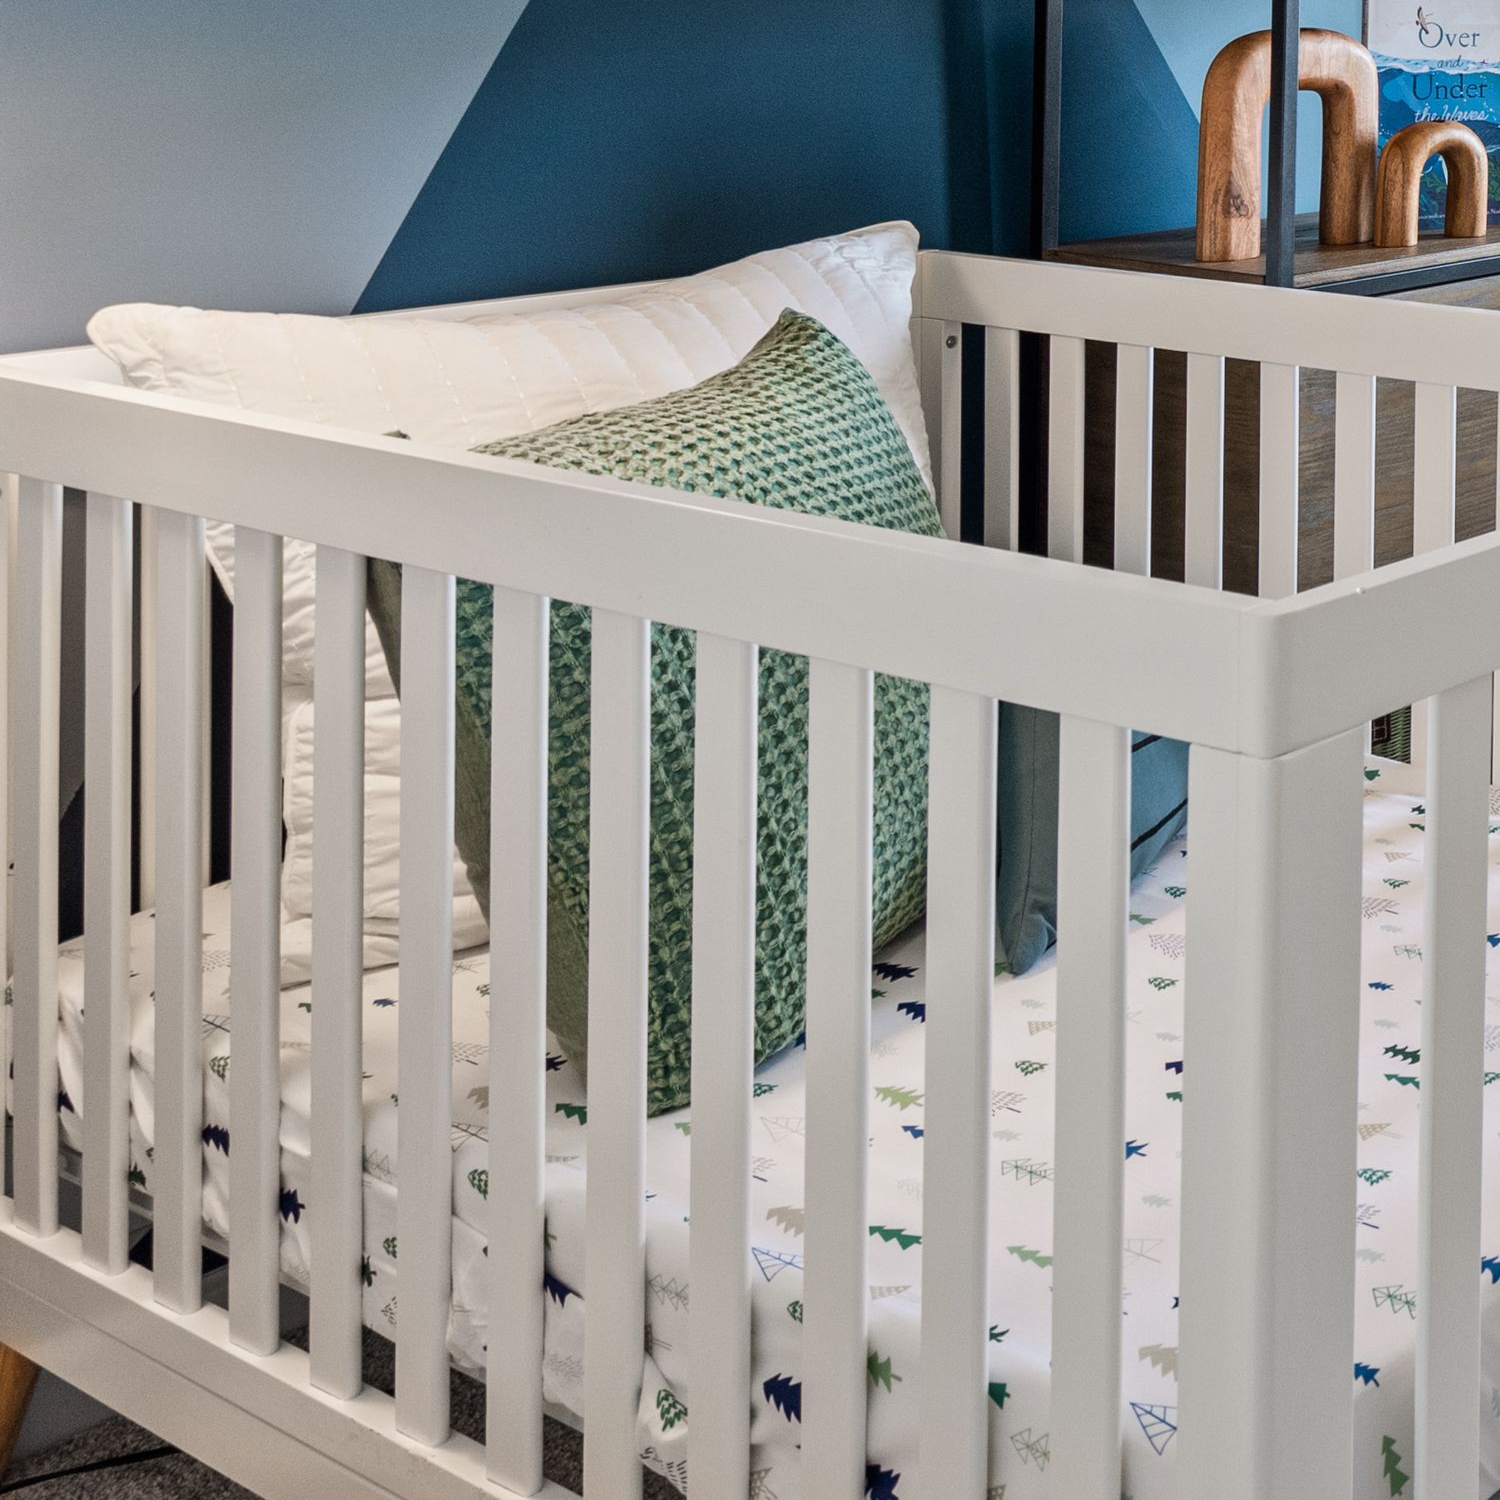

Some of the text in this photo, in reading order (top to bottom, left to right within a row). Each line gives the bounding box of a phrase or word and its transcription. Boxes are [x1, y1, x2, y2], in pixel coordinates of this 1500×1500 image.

[1418, 21, 1480, 49] Over
[1437, 54, 1464, 69] and
[1411, 72, 1488, 101] Under
[1414, 104, 1490, 123] the Waves
